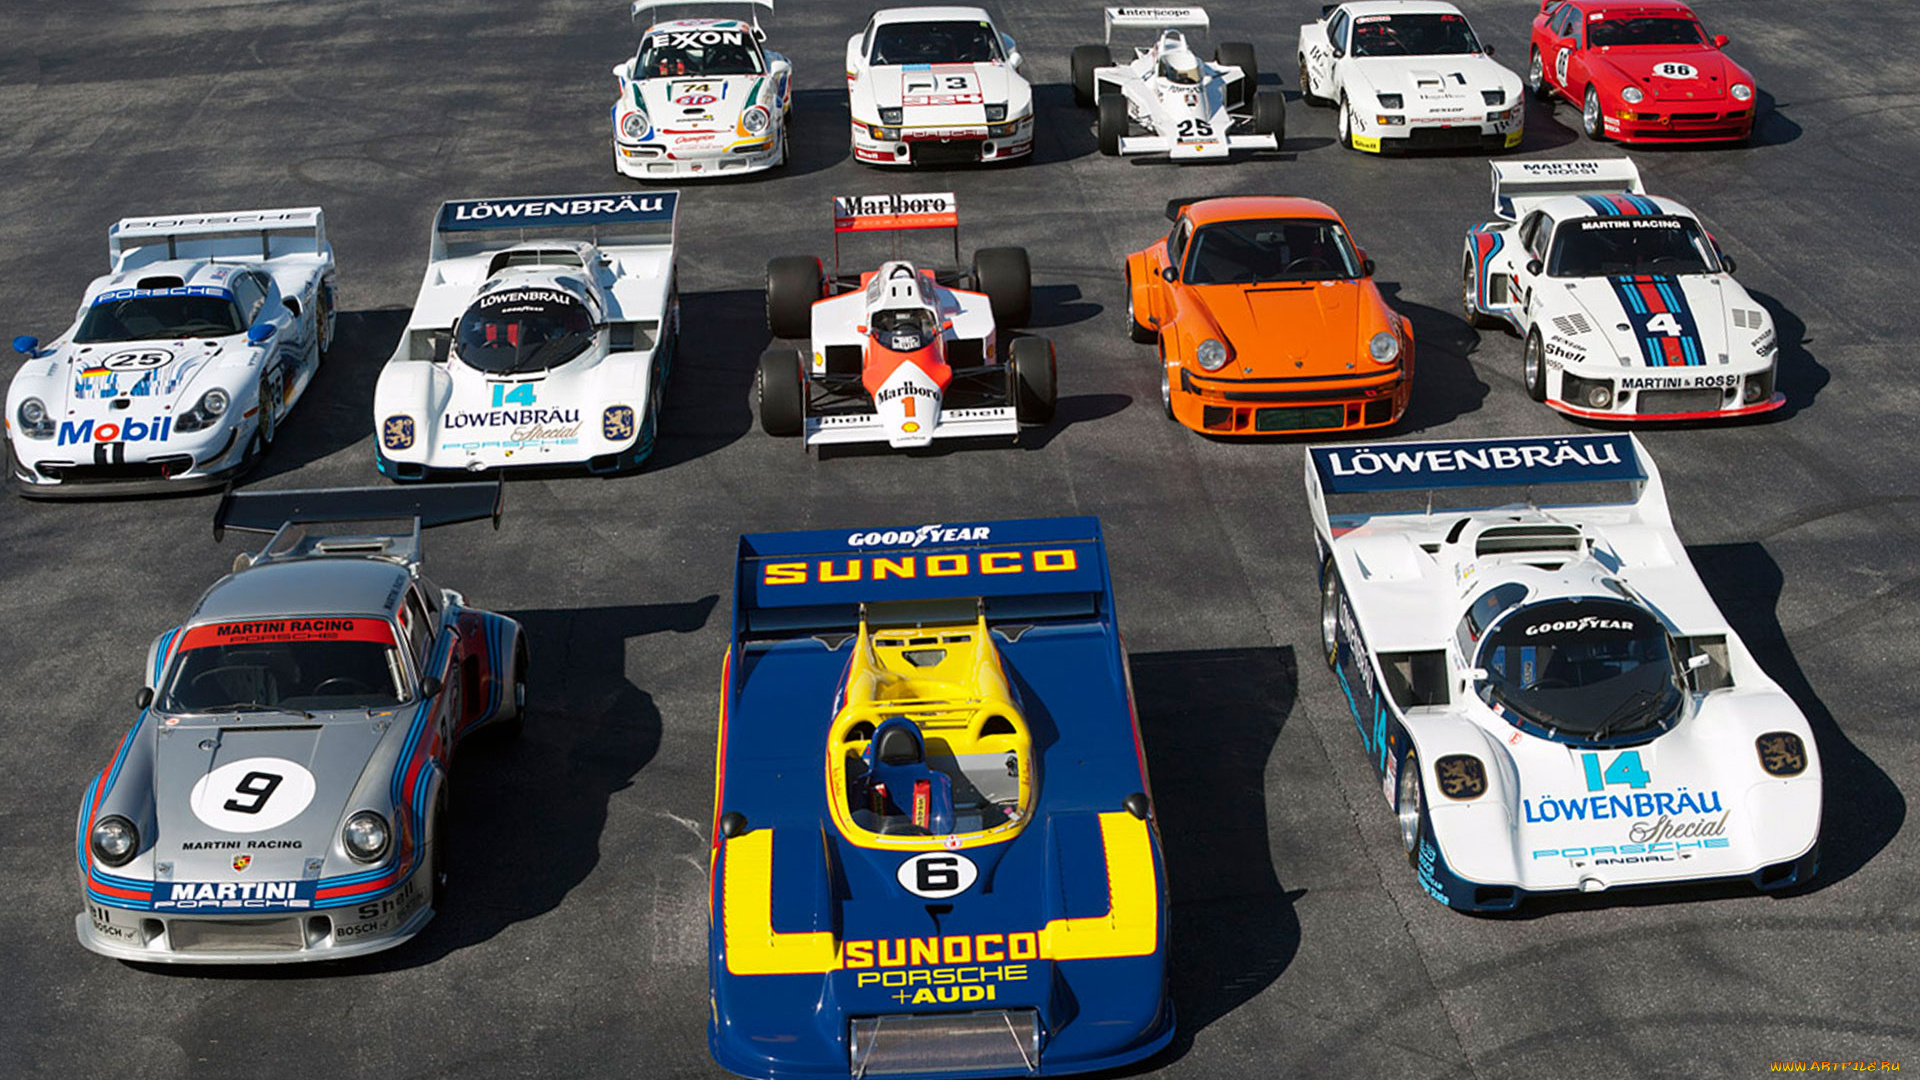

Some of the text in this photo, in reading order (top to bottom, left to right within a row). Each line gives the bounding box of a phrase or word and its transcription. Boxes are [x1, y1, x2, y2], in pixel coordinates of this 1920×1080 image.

[652, 31, 742, 49] EXXON
[1663, 64, 1690, 76] 86
[683, 84, 709, 93] 74
[946, 77, 967, 89] 3
[1177, 118, 1214, 137] 25
[1410, 116, 1483, 124] PORSCHE
[1523, 162, 1599, 171] MARTINI
[455, 195, 663, 220] LÖWENBRÄU
[845, 194, 946, 216] Marlboro
[125, 212, 313, 229] PORSCHE
[1581, 219, 1681, 231] MARTINI RACING
[98, 287, 224, 302] PORSCHE
[480, 289, 570, 309] LÖWENBRÄU
[1645, 312, 1683, 337] 4
[111, 353, 163, 367] 25
[1545, 342, 1586, 363] Shell
[1622, 377, 1681, 389] MARTINI
[1694, 374, 1740, 387] ROSSI
[491, 382, 537, 408] 14
[877, 381, 941, 405] Marlboro
[900, 396, 916, 418] 1
[949, 408, 1005, 418] Shell
[444, 406, 579, 429] LÖWENBRÄU
[816, 415, 871, 425] Shell
[57, 416, 172, 447] Mobil
[510, 420, 584, 449] Special
[102, 443, 115, 464] 1
[442, 438, 579, 450] PORSCHE
[1328, 440, 1621, 476] LÖWENBRÄU
[848, 524, 990, 548] GOODYEAR
[763, 548, 1077, 586] SUNOCO
[217, 620, 354, 636] MARTINI RACING
[1525, 616, 1634, 636] GOODYEAR
[229, 632, 339, 642] PORSCHE
[1580, 750, 1651, 792] 14
[223, 771, 284, 815] 9
[1523, 787, 1723, 823] LÖWENBRÄU
[1629, 809, 1731, 852] Special
[182, 840, 303, 850] MARTINI RACING
[1532, 837, 1730, 860] PORSCHE
[1595, 856, 1675, 866] ANDIAL
[916, 857, 959, 892] 6
[170, 882, 297, 900] MARTINI
[358, 881, 413, 920] Shell
[154, 899, 310, 909] PORSCHE
[336, 922, 378, 937] BOSCH
[845, 931, 1037, 969] SUNOCO
[857, 964, 1028, 988] PORSCHE
